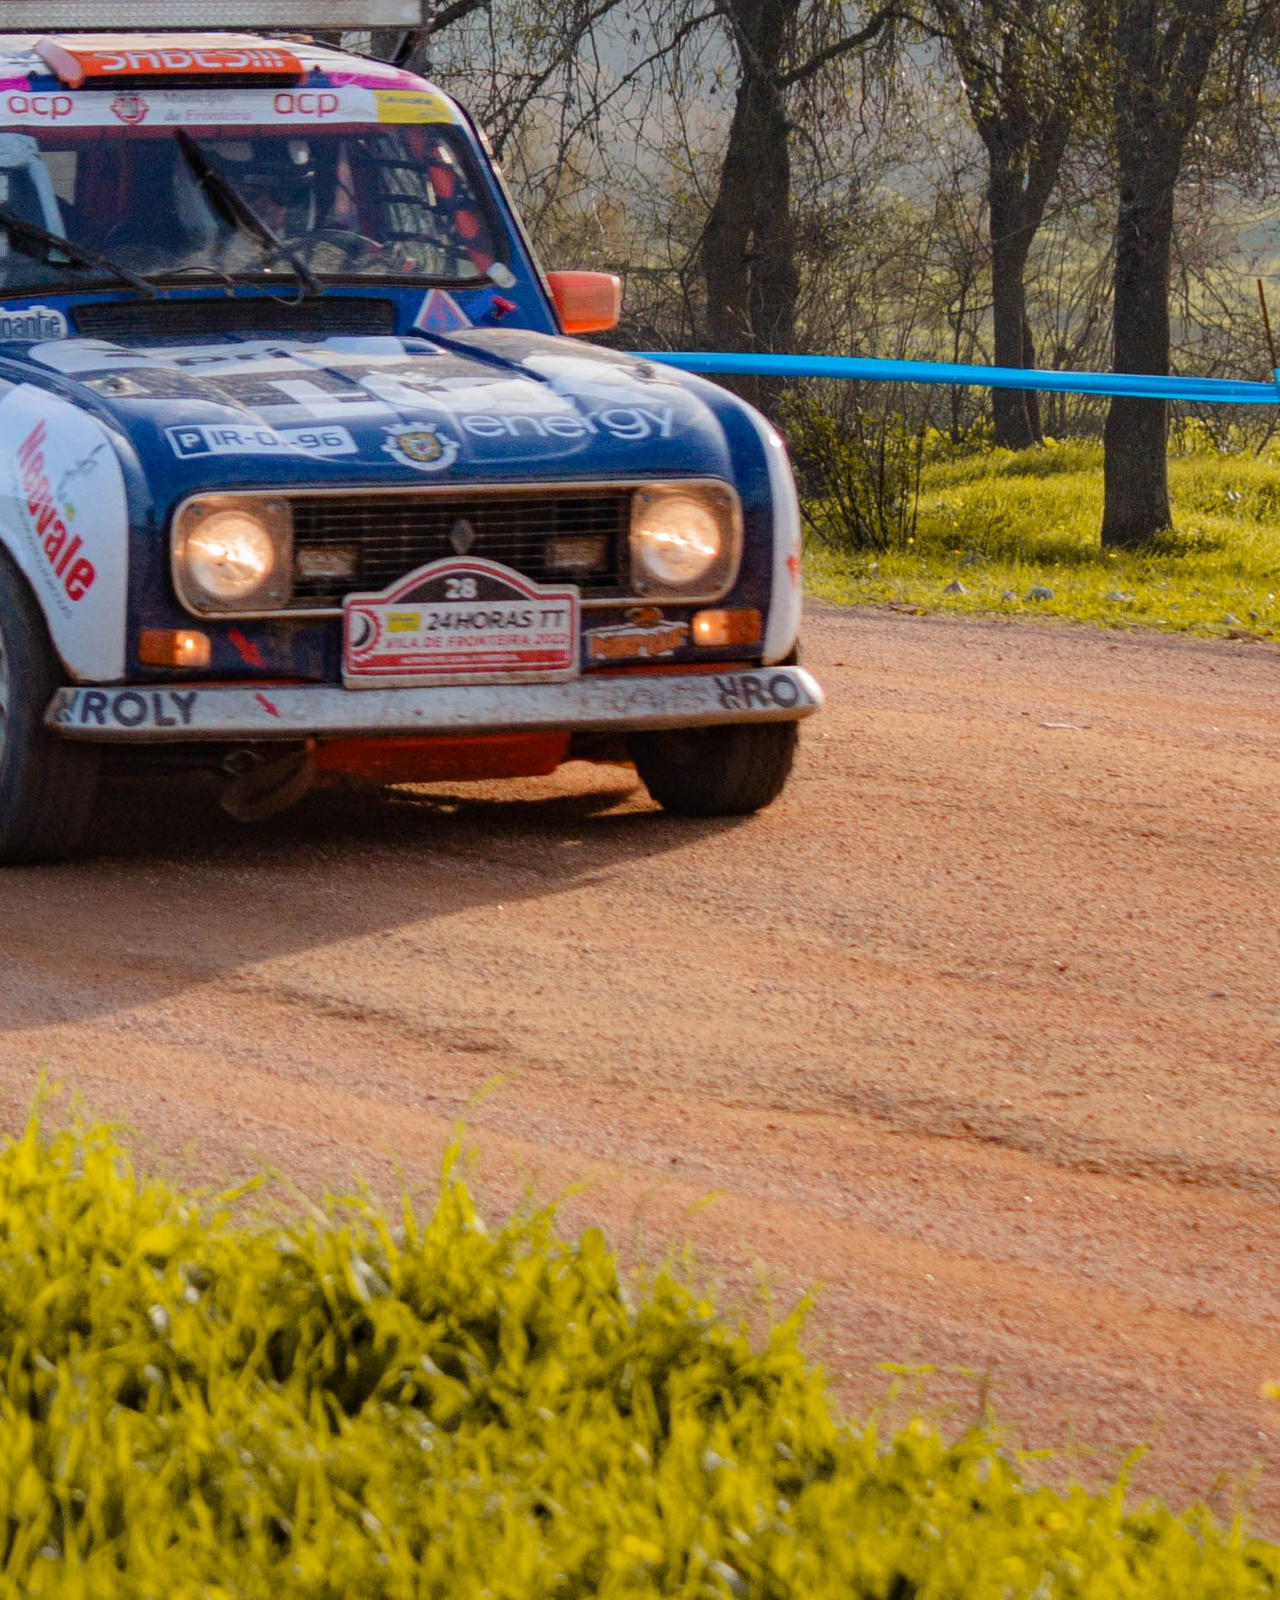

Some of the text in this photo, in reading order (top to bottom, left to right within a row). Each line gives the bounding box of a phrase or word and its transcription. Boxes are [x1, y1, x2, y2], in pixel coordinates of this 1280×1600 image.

[6, 95, 73, 120] acp
[273, 92, 340, 118] acp
[459, 406, 674, 440] energy
[444, 578, 478, 599] 28
[79, 690, 199, 728] ROLY
